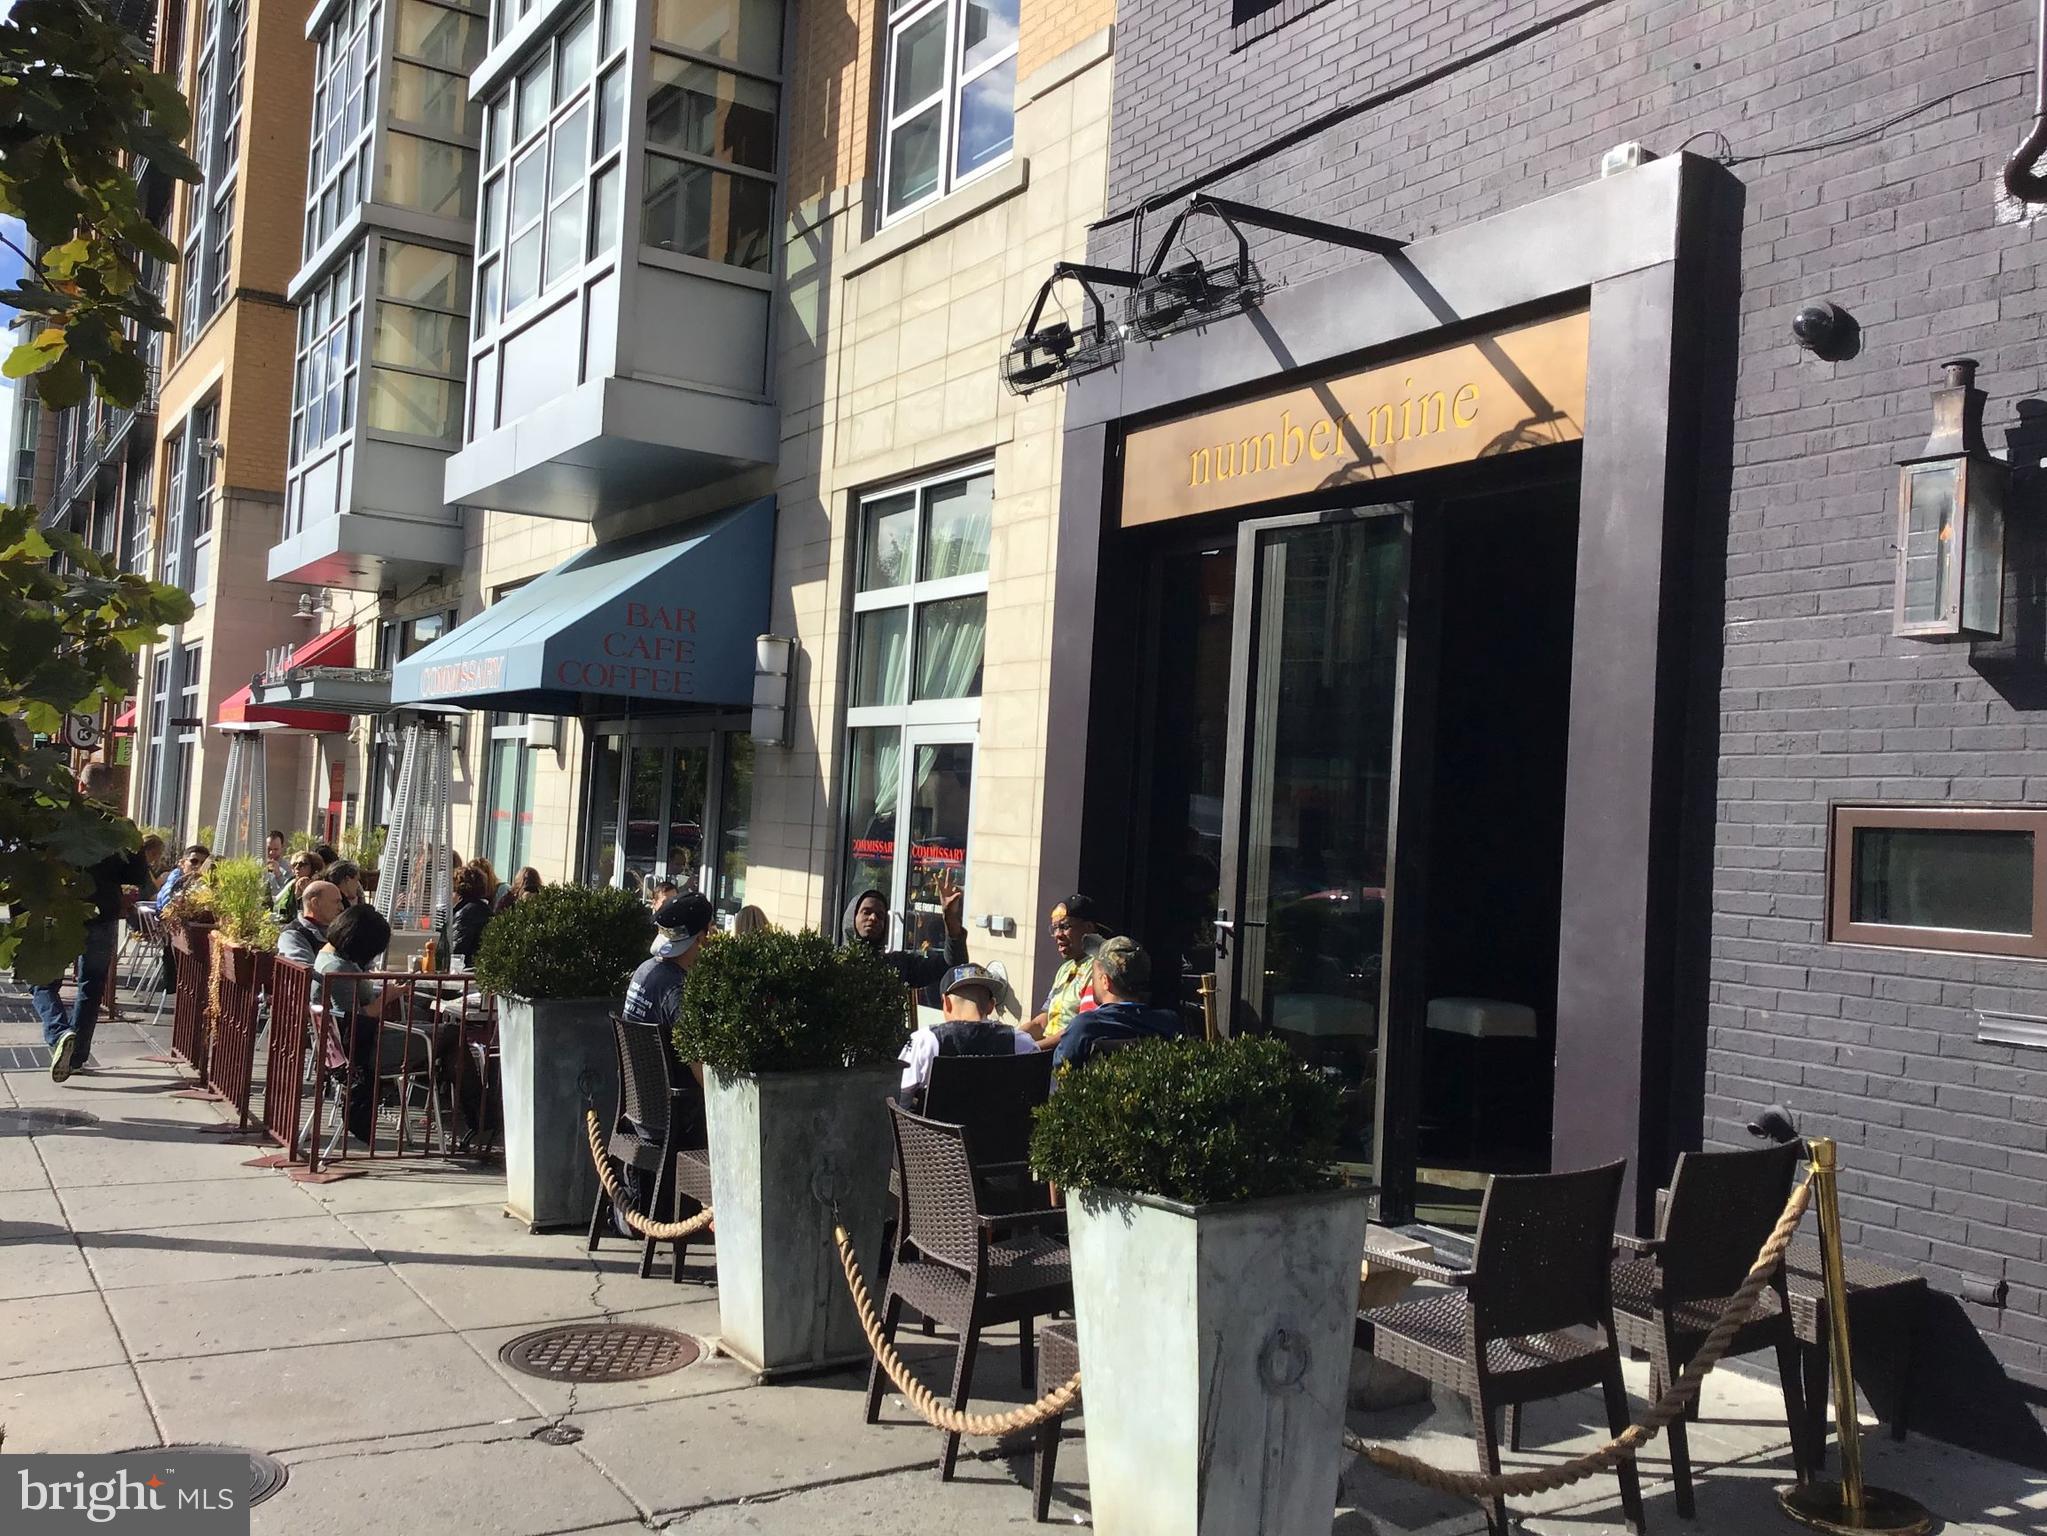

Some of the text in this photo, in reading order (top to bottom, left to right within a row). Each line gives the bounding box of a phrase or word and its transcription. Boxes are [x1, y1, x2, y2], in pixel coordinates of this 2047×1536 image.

[1188, 378, 1481, 488] number nine
[626, 602, 696, 633] BAR
[604, 632, 696, 664] CAFE
[420, 655, 505, 698] COMMISSARY
[558, 660, 694, 695] COFFEE
[852, 839, 894, 853] COMMISSAR
[911, 845, 966, 861] COMMISSARY
